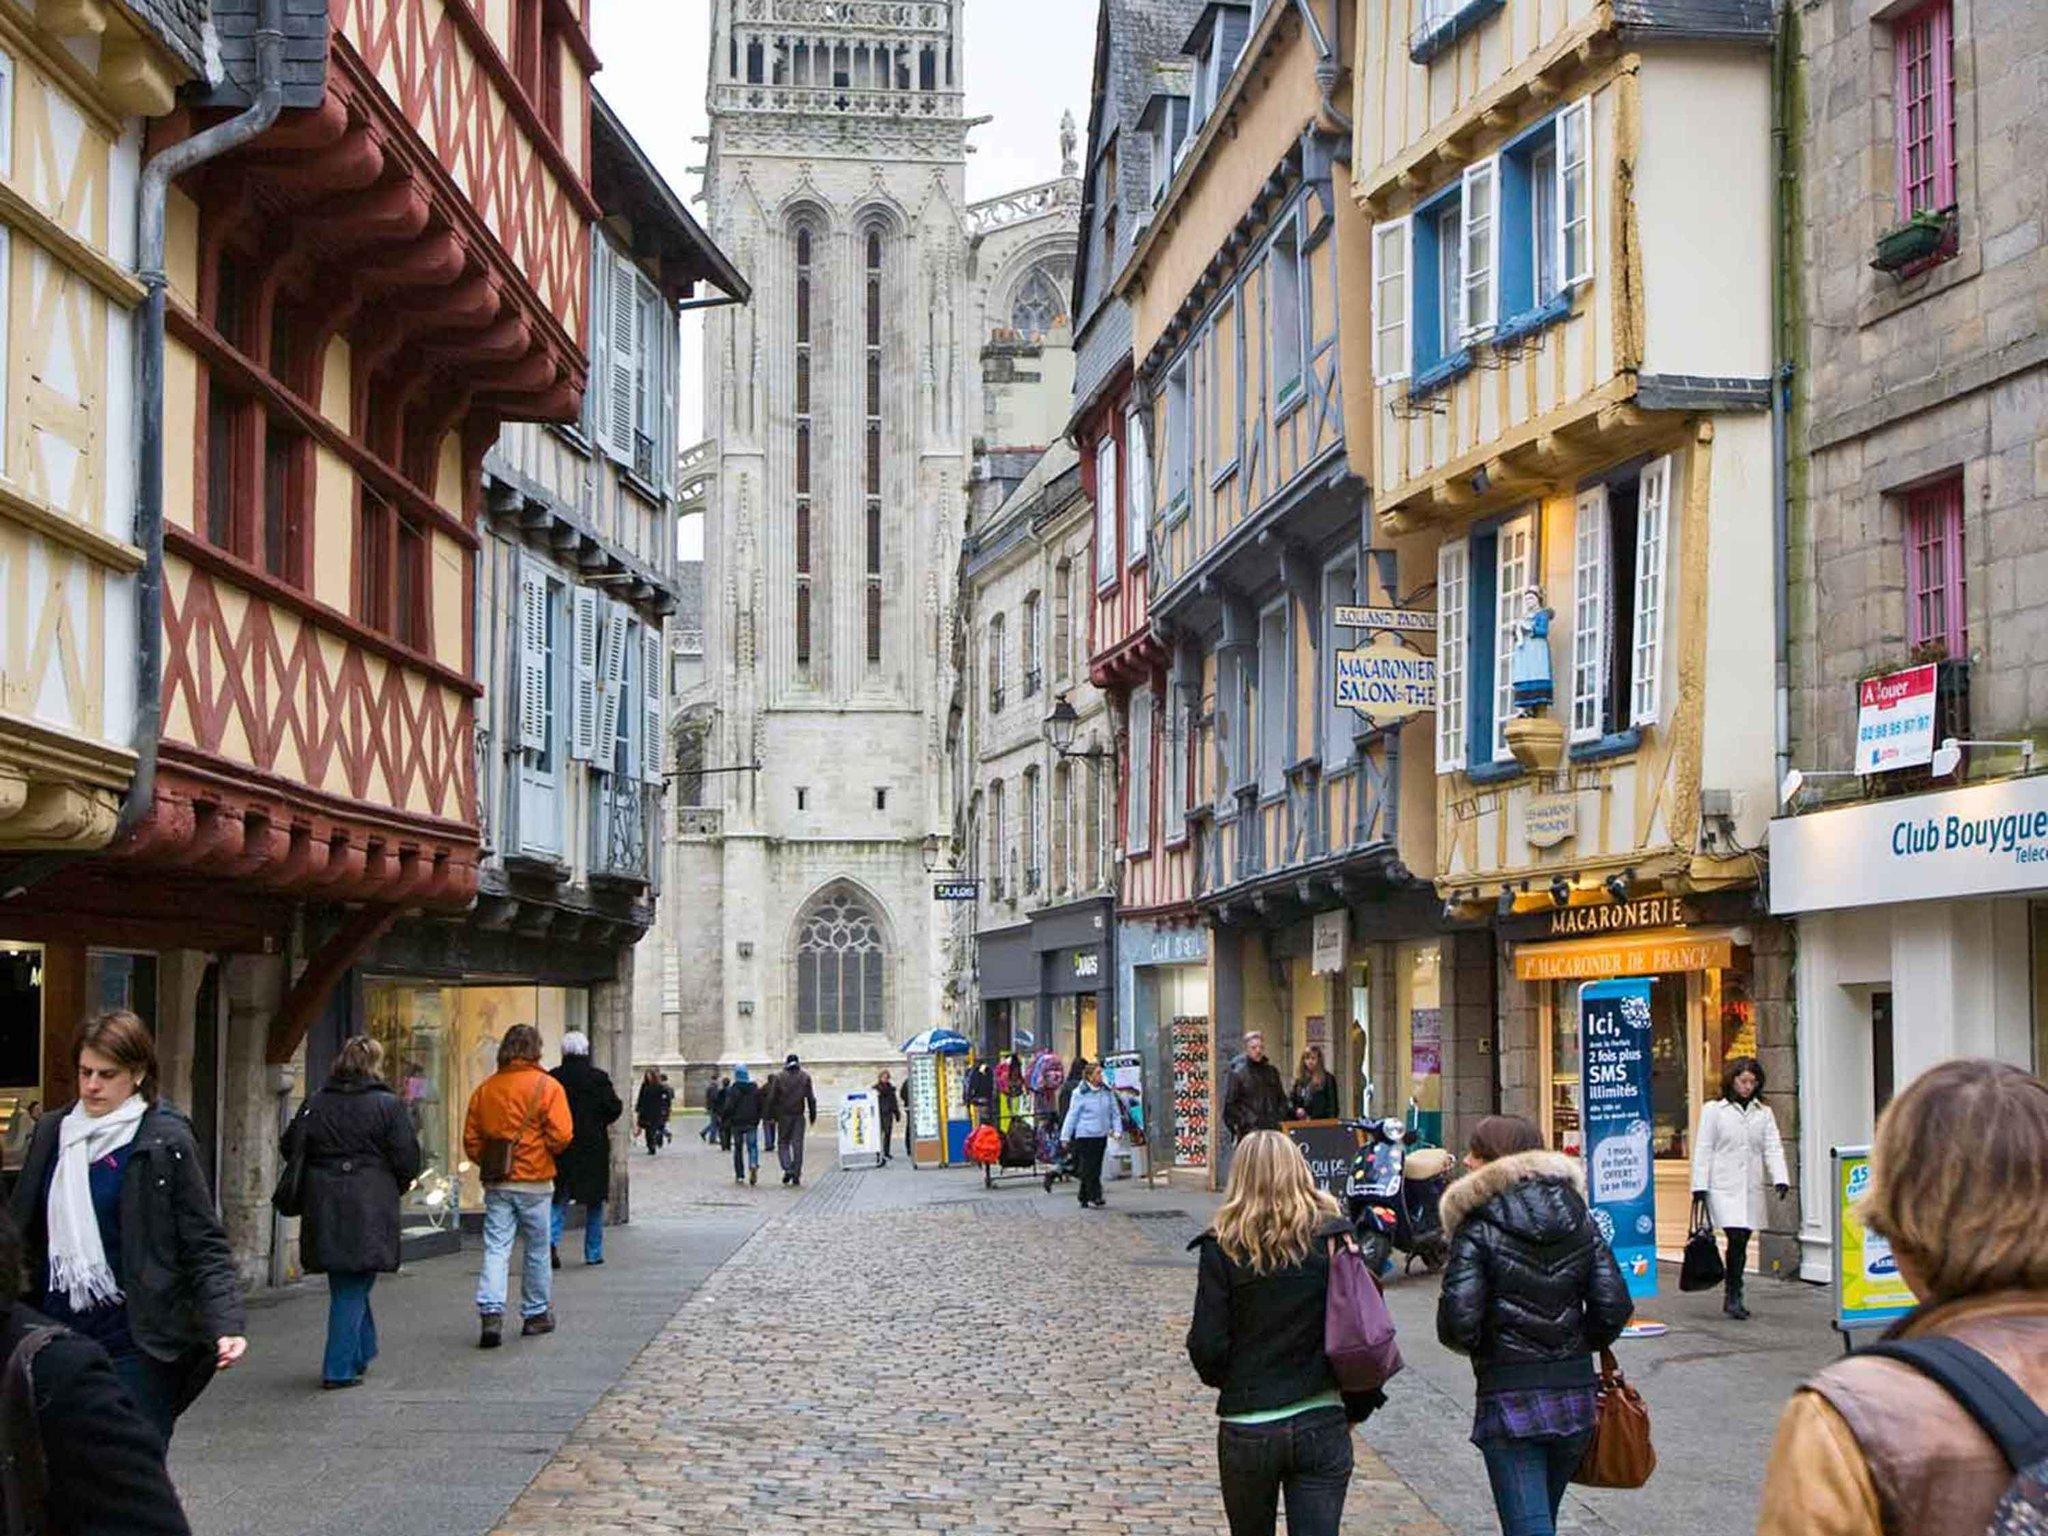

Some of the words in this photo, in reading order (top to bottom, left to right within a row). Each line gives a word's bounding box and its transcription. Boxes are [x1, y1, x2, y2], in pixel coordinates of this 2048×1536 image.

[1338, 680, 1397, 702] SALON
[1864, 685, 1875, 703] A
[1877, 681, 1909, 701] louer
[1892, 819, 1940, 855] Club
[1945, 810, 2048, 853] Bouygue
[2015, 845, 2048, 863] Telec
[1551, 898, 1683, 934] MACARONERIE
[1627, 951, 1646, 971] DE
[1653, 945, 1709, 969] FRANCE
[1588, 1011, 1620, 1037] Ici,
[1589, 1051, 1596, 1063] 2
[1598, 1049, 1617, 1062] fois
[1619, 1047, 1642, 1064] plus
[1589, 1063, 1627, 1084] SMS
[1589, 1083, 1639, 1100] illimités
